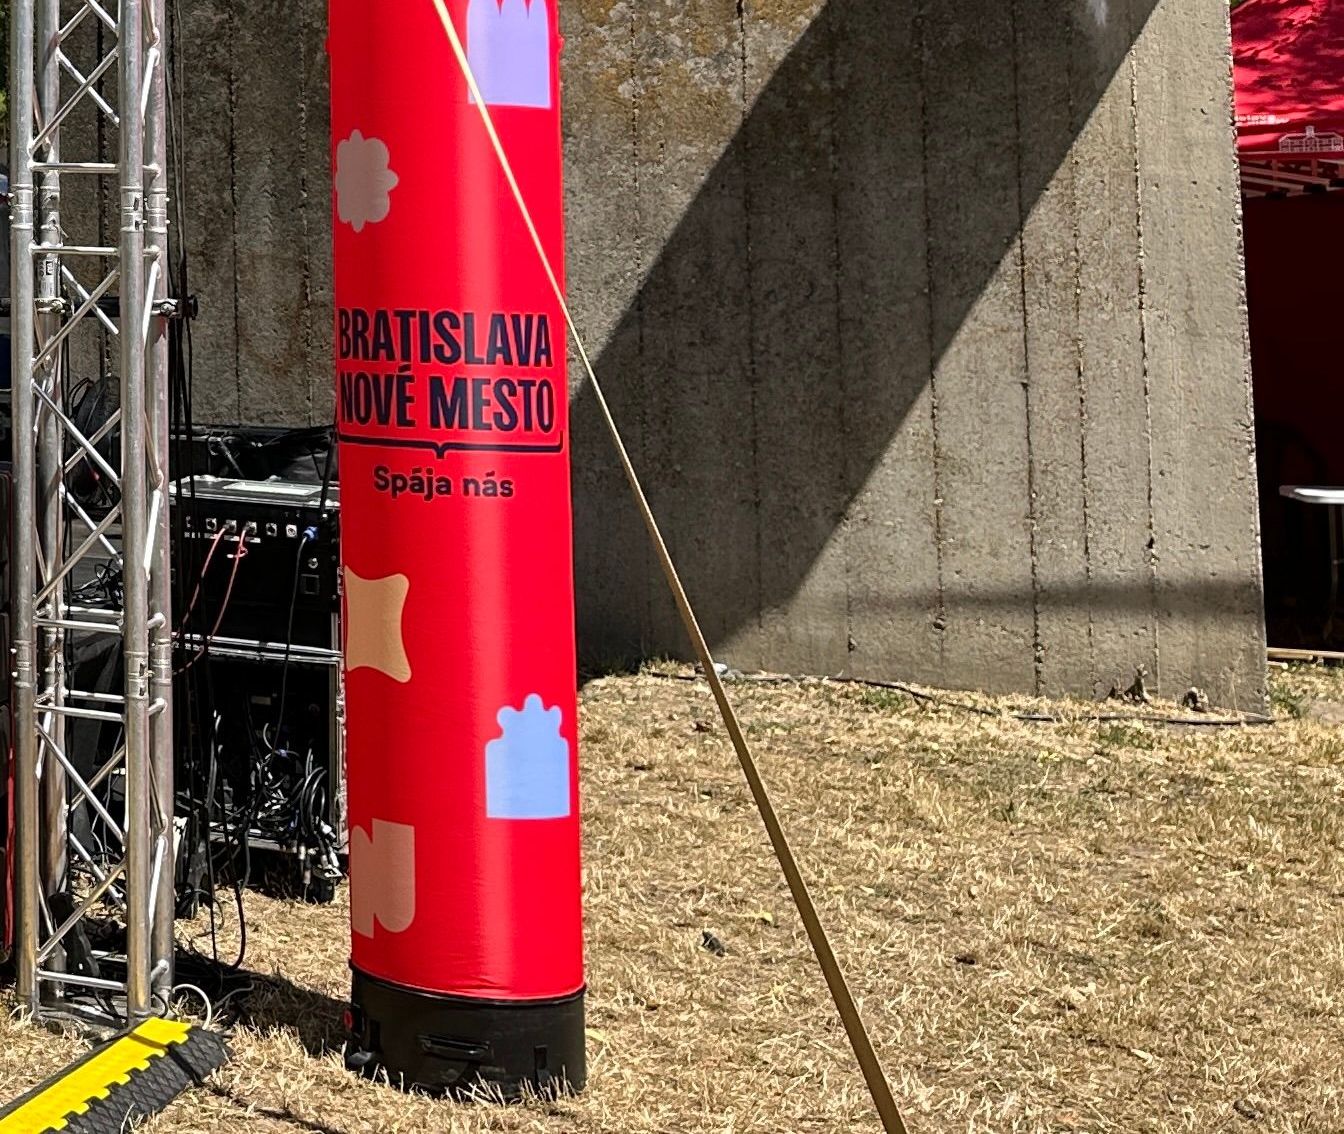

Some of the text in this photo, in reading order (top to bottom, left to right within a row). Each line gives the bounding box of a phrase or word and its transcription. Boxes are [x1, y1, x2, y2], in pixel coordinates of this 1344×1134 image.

[339, 308, 553, 367] BRATISLAVA
[340, 364, 554, 433] NOVÉ MESTO
[374, 465, 514, 501] Spája nás
